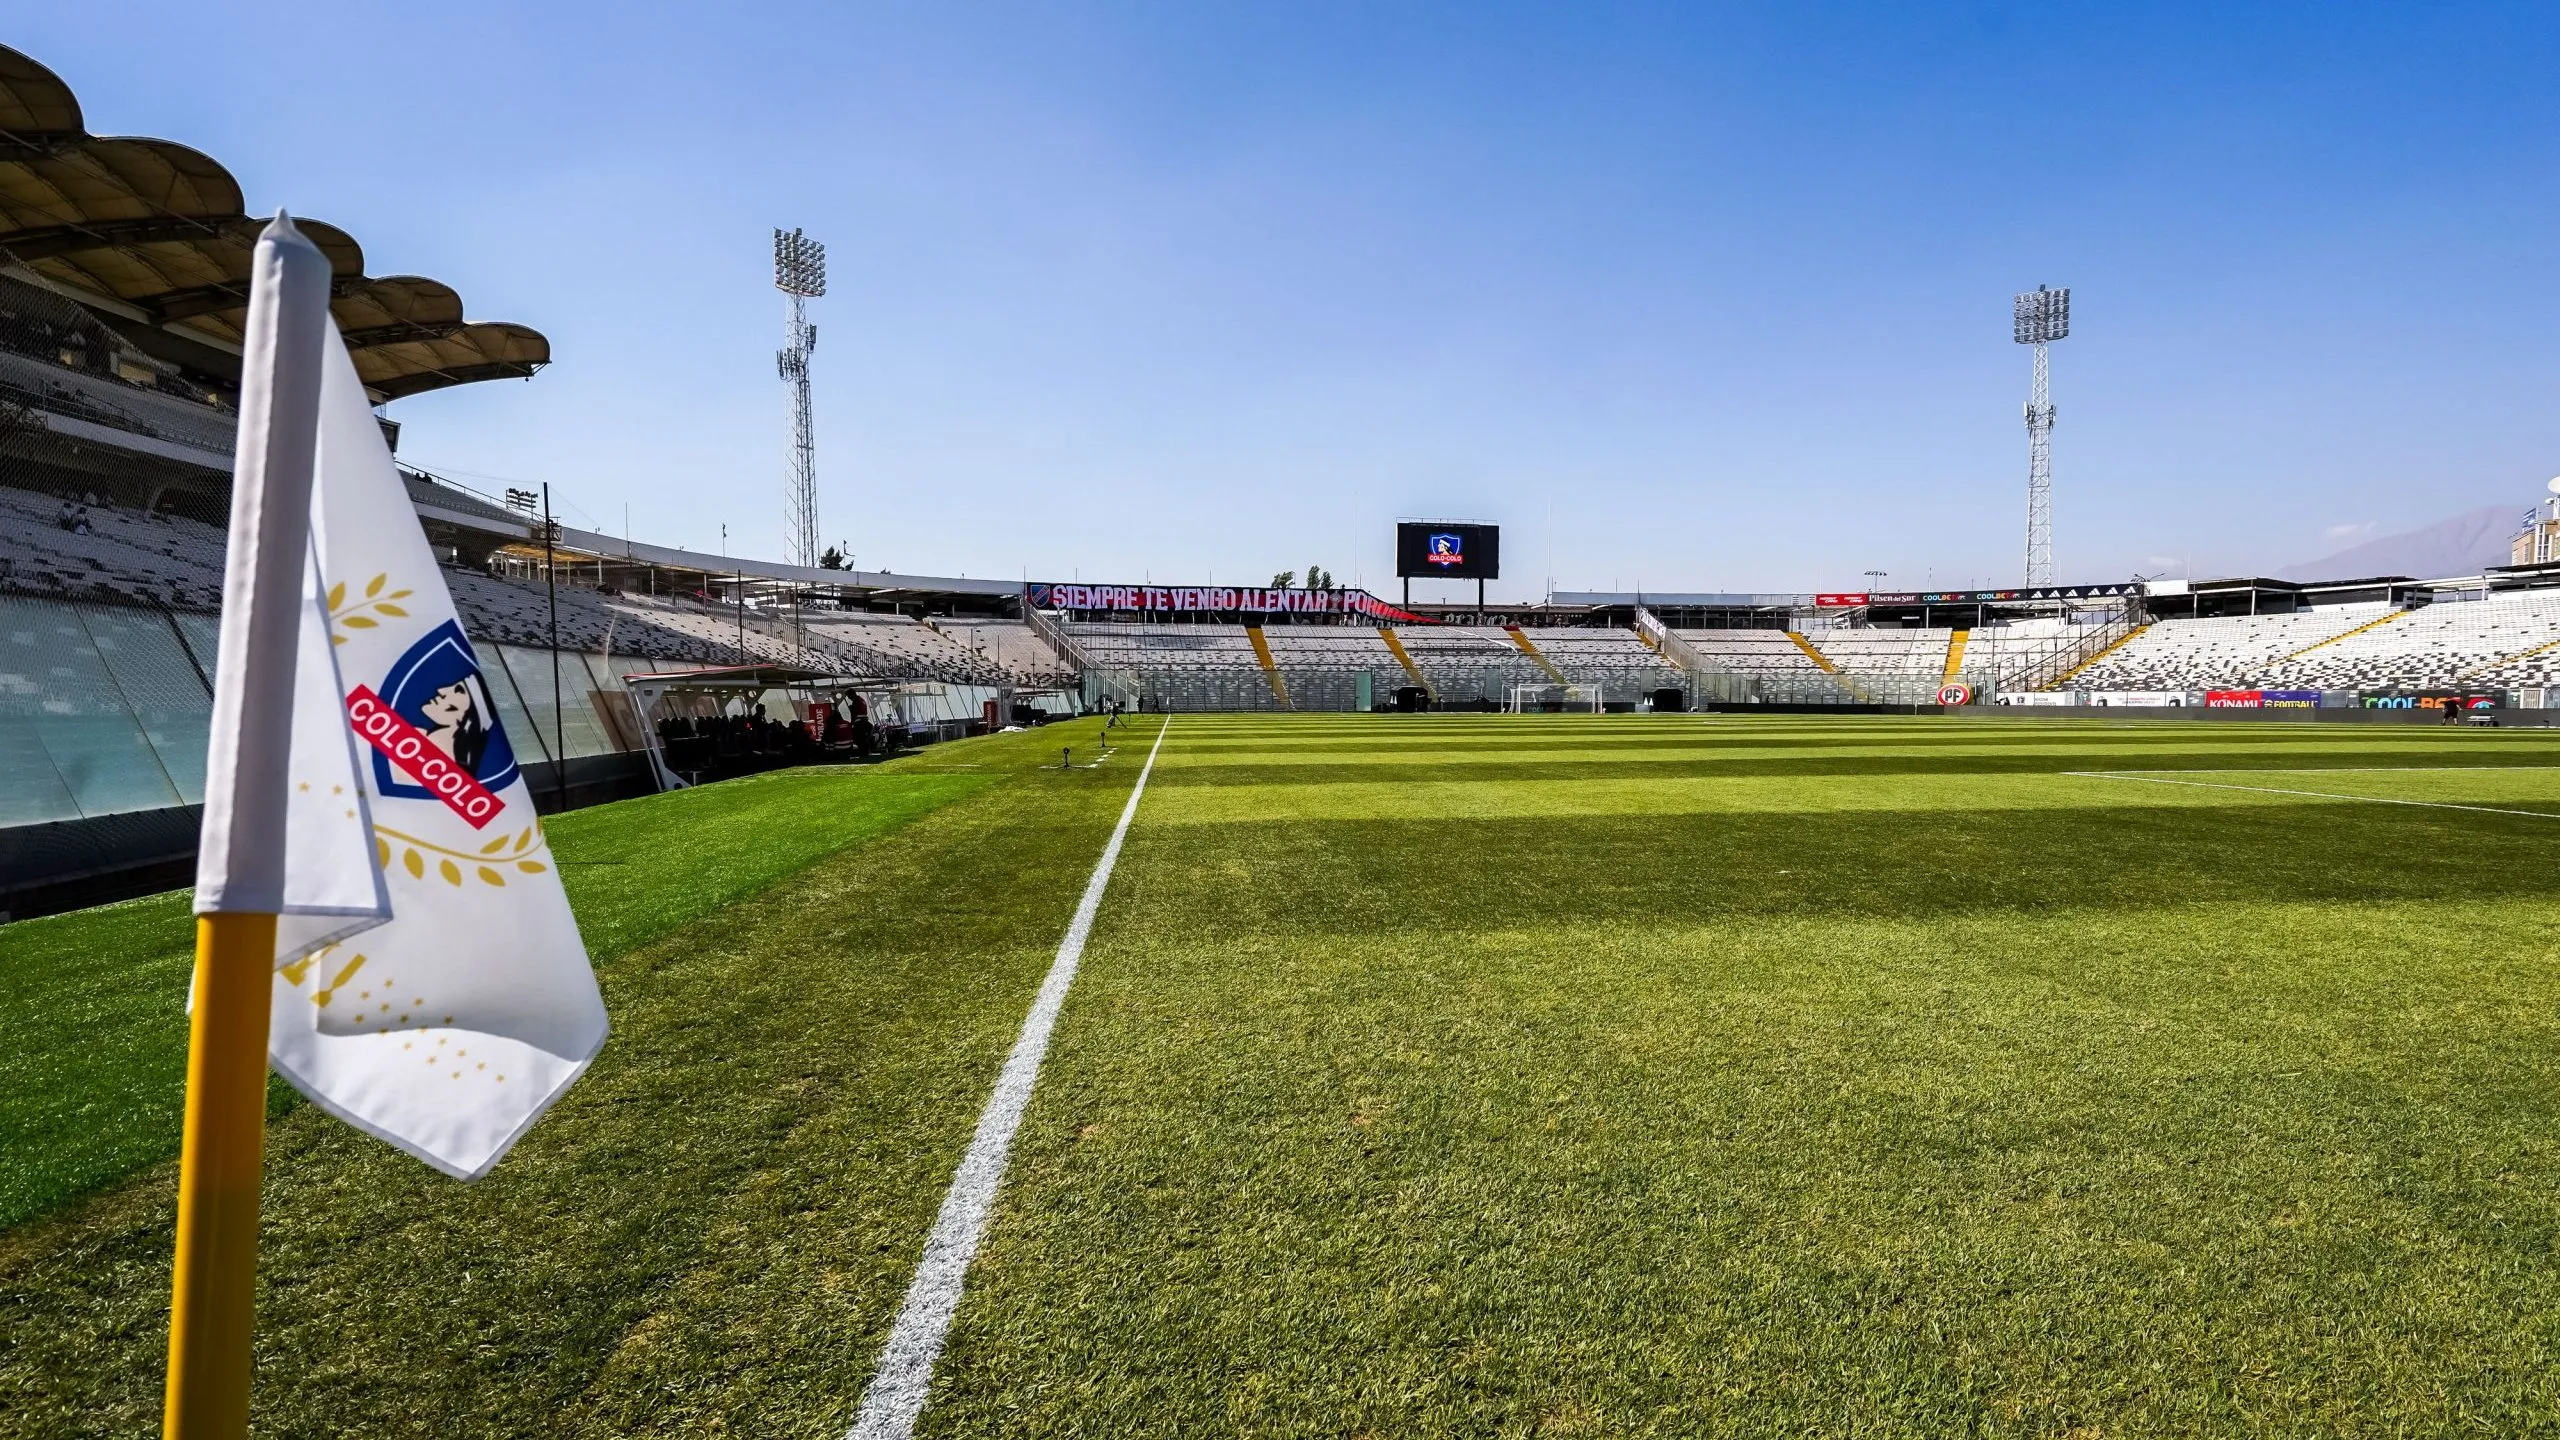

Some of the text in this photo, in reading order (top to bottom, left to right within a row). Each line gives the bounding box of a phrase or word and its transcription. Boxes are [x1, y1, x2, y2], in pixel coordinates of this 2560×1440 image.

[1052, 585, 1139, 610] SIEMPRE
[1142, 586, 1169, 611] TE
[1171, 588, 1236, 611] VENGO
[1239, 589, 1328, 613] ALENTAR
[1869, 594, 1893, 602] Pilsen
[1944, 688, 1961, 702] PF
[2209, 699, 2258, 708] KONAMI
[349, 698, 492, 818] COLO-COLO
